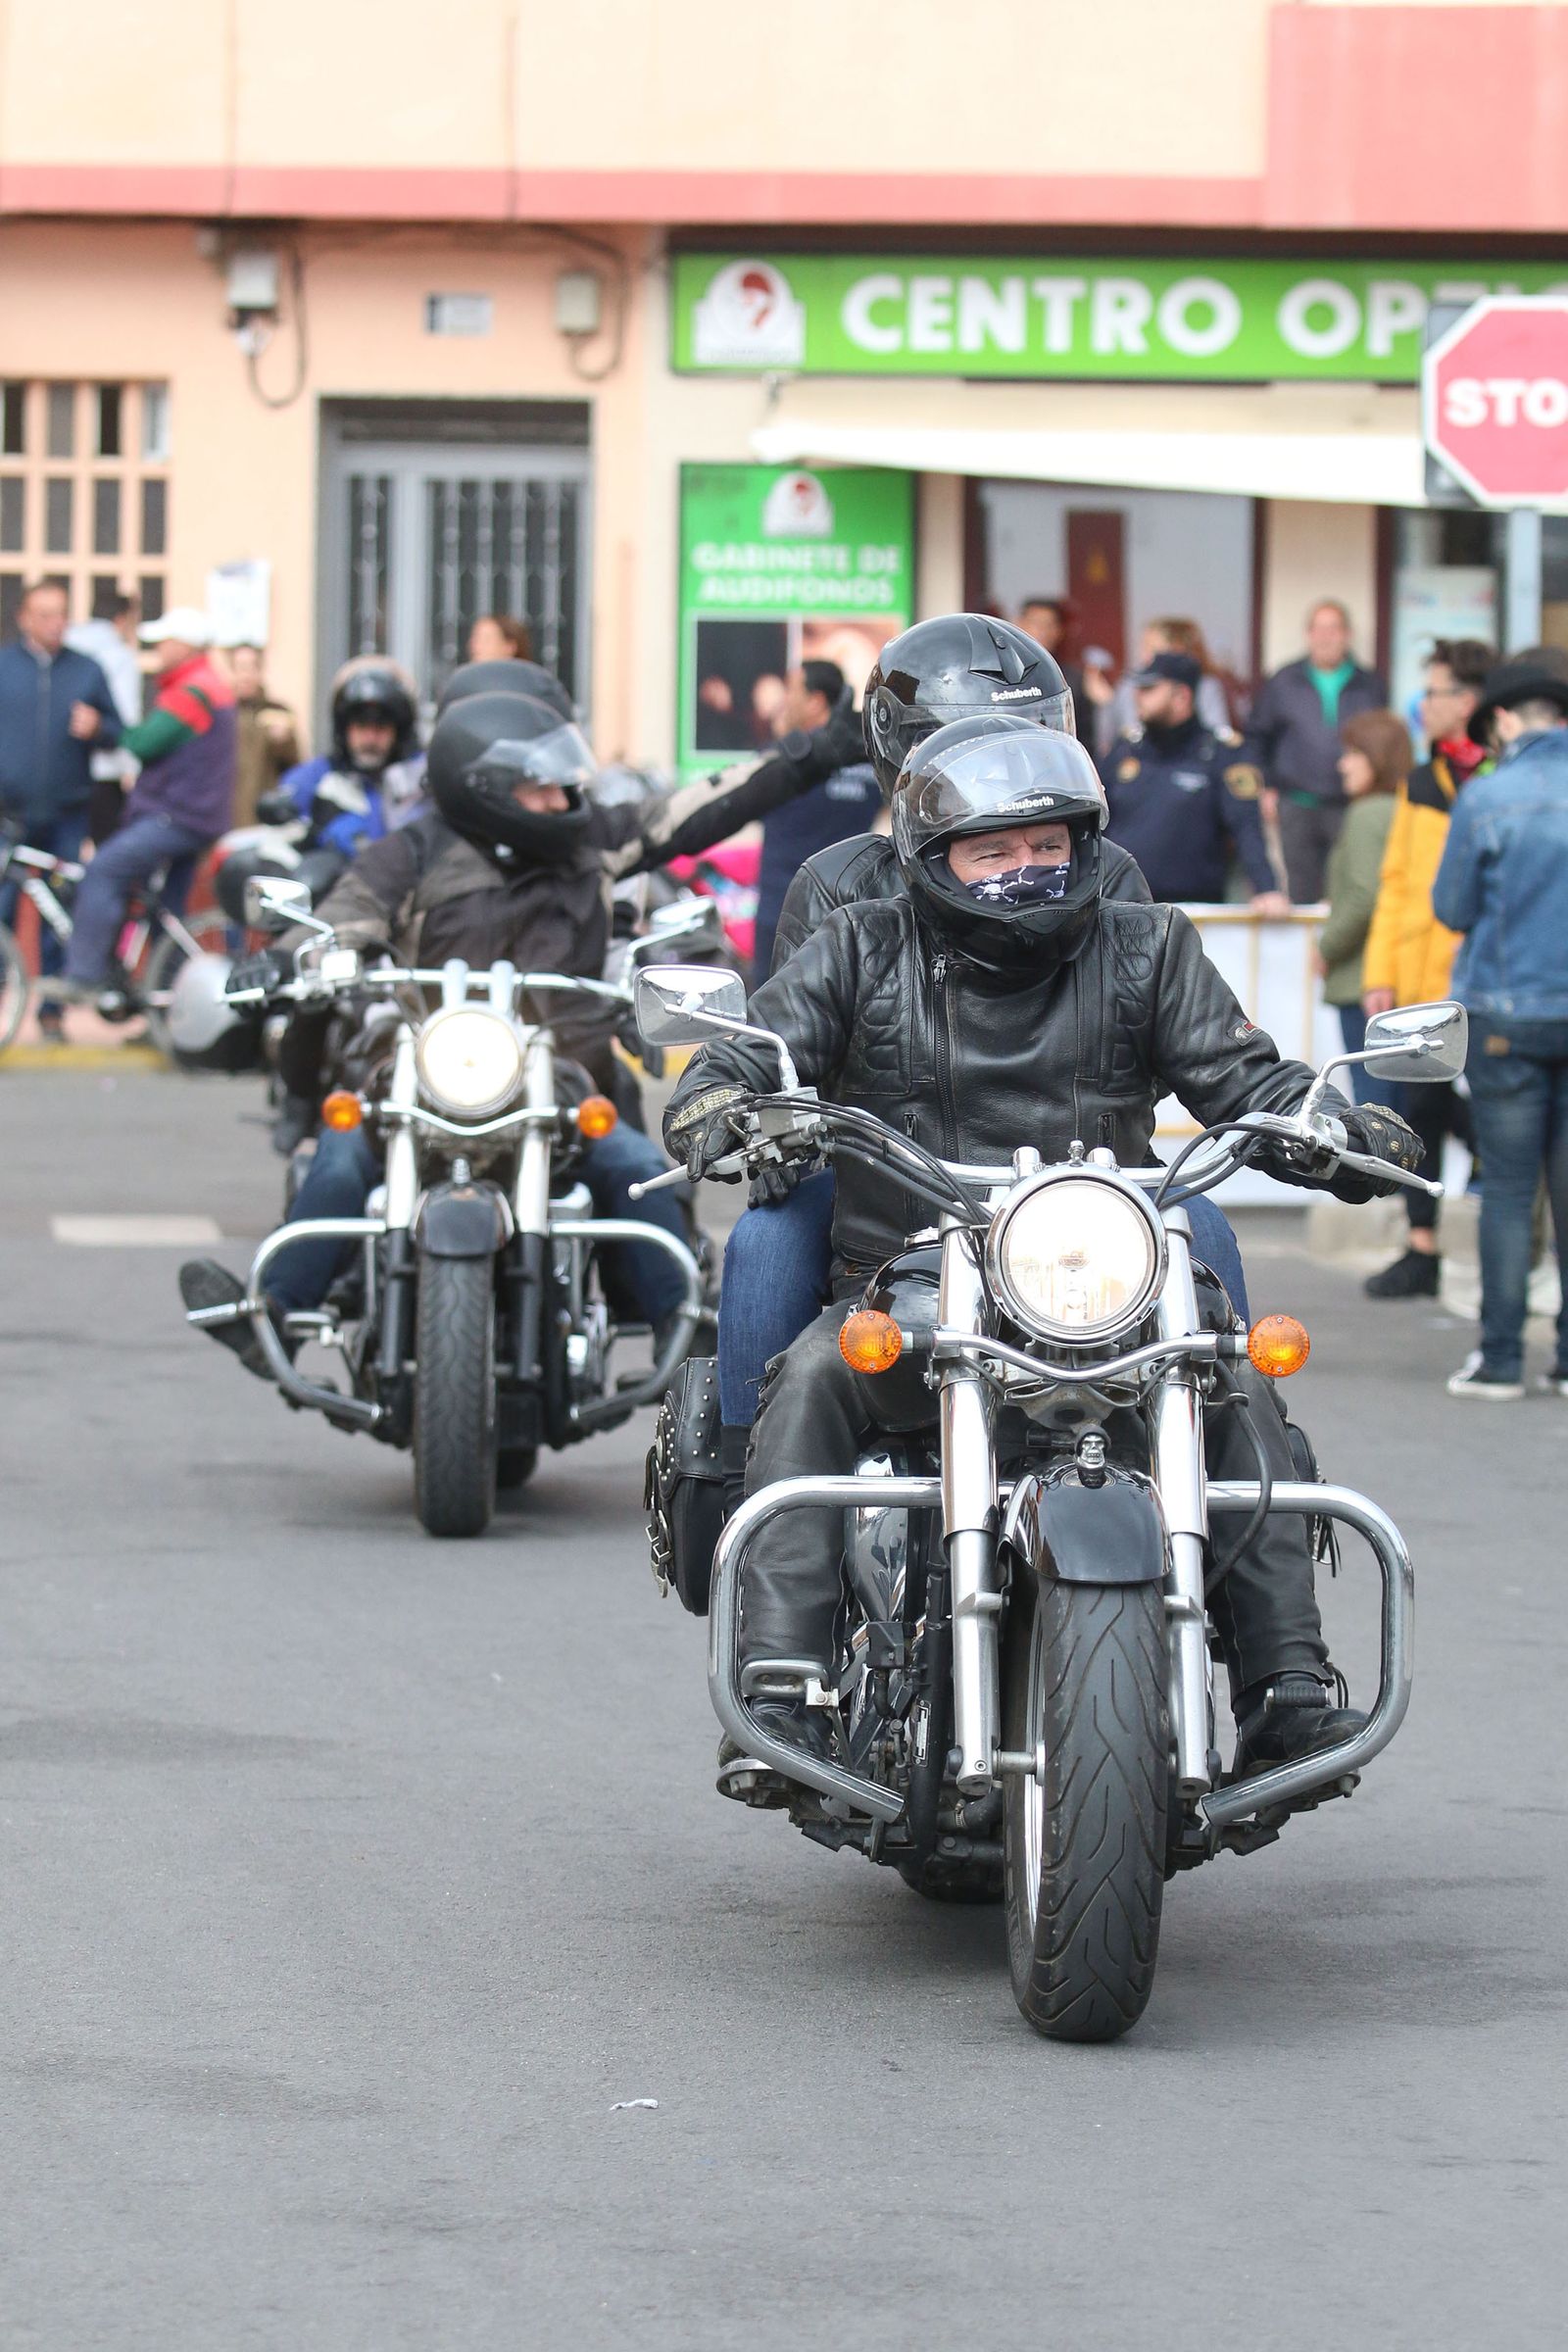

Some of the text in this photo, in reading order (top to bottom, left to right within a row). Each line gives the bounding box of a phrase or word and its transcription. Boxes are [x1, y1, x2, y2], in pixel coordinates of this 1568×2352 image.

[842, 273, 1242, 356] CENTRO
[692, 543, 900, 573] GABINETE DE
[991, 687, 1042, 702] Schuberth
[997, 796, 1054, 813] Schuberth
